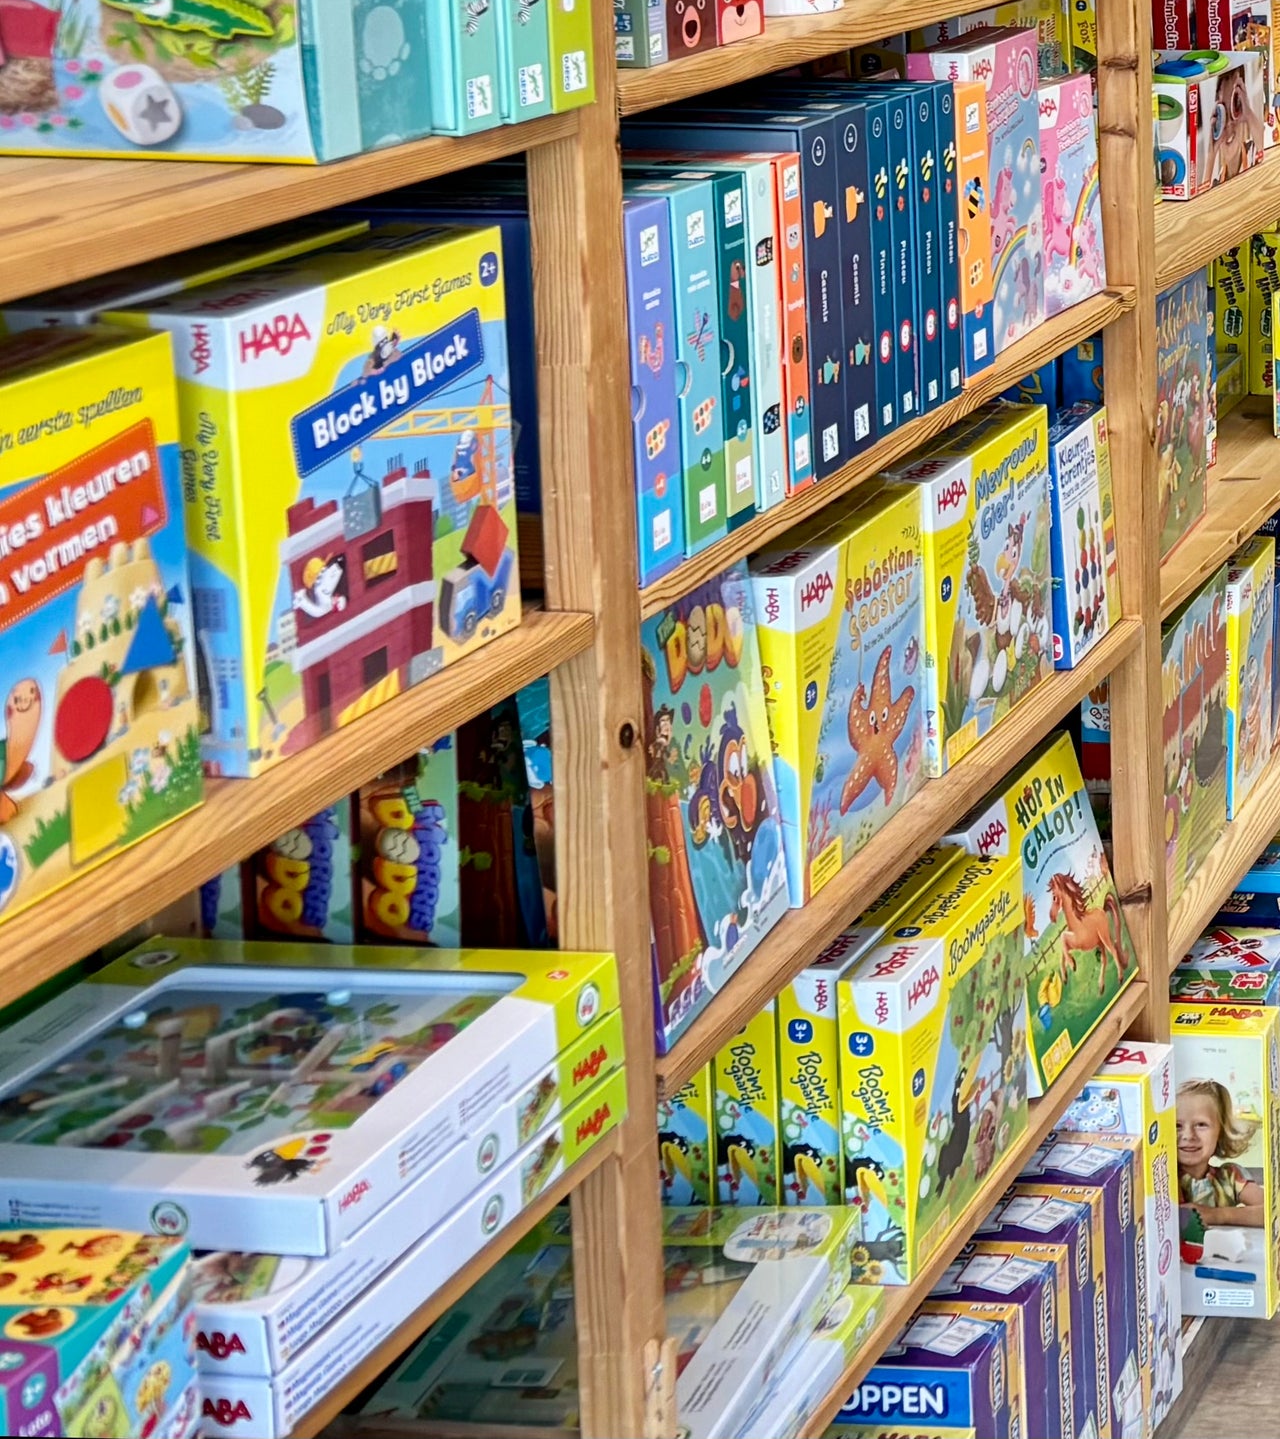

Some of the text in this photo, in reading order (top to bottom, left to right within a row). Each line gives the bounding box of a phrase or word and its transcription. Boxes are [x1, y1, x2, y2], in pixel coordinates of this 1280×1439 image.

[972, 59, 993, 81] HABA
[239, 313, 311, 363] HABA
[358, 292, 391, 326] Very
[395, 280, 430, 312] First
[430, 271, 473, 300] Games
[190, 323, 213, 374] HABA
[76, 385, 143, 427] spellen
[311, 335, 469, 451] Block by Block
[975, 429, 1038, 510] Mevrouw
[1059, 435, 1089, 470] Kleuren
[1060, 449, 1096, 489] torentjes
[48, 449, 151, 519] kleuren
[937, 478, 967, 514] HABA
[980, 477, 1016, 540] Gier!
[13, 514, 118, 596] vormen
[766, 586, 779, 625] HABA
[801, 570, 833, 612] HABA
[1015, 774, 1066, 830] HOP IN
[977, 819, 1006, 856] HABA
[1022, 795, 1084, 869] GALOP!
[815, 979, 827, 1012] HABA
[875, 992, 888, 1025] HABA
[908, 966, 939, 1010] HABA
[1209, 1006, 1266, 1021] HABA
[572, 1042, 609, 1086] HABA
[575, 1101, 611, 1145] HABA
[336, 1179, 372, 1214] HABA
[842, 1385, 944, 1414] OPPEN
